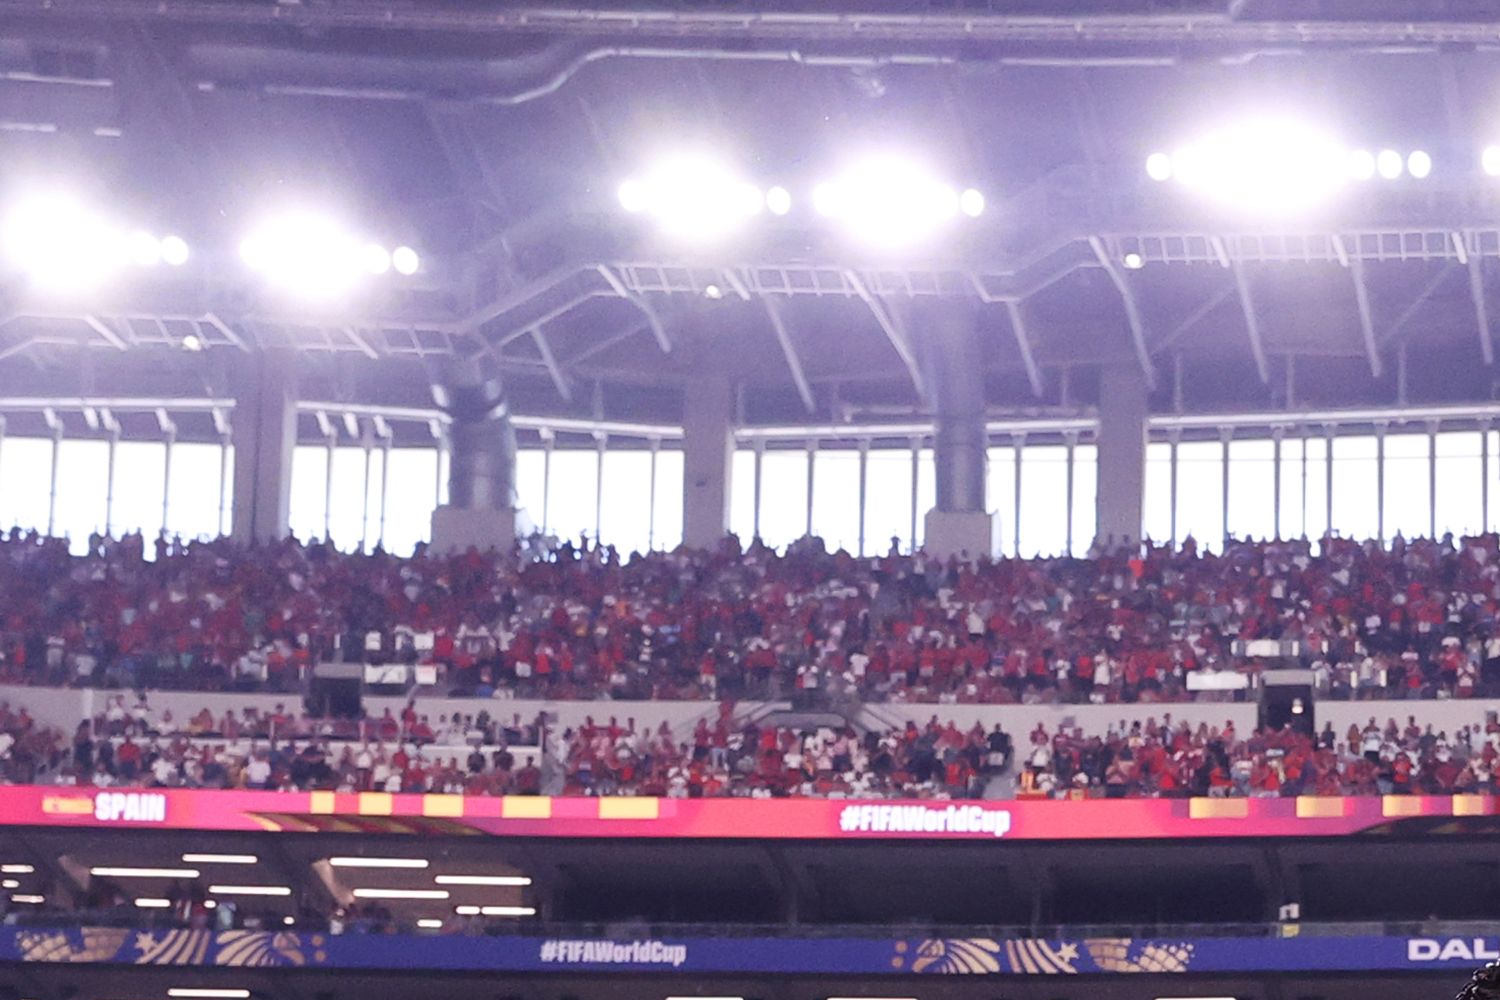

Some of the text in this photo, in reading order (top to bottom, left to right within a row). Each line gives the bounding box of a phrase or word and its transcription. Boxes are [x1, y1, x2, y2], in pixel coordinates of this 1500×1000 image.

[95, 792, 166, 822] SPAIN
[839, 805, 1011, 837] #FIFAWorldCup
[540, 940, 687, 967] #FIFAWorldCup
